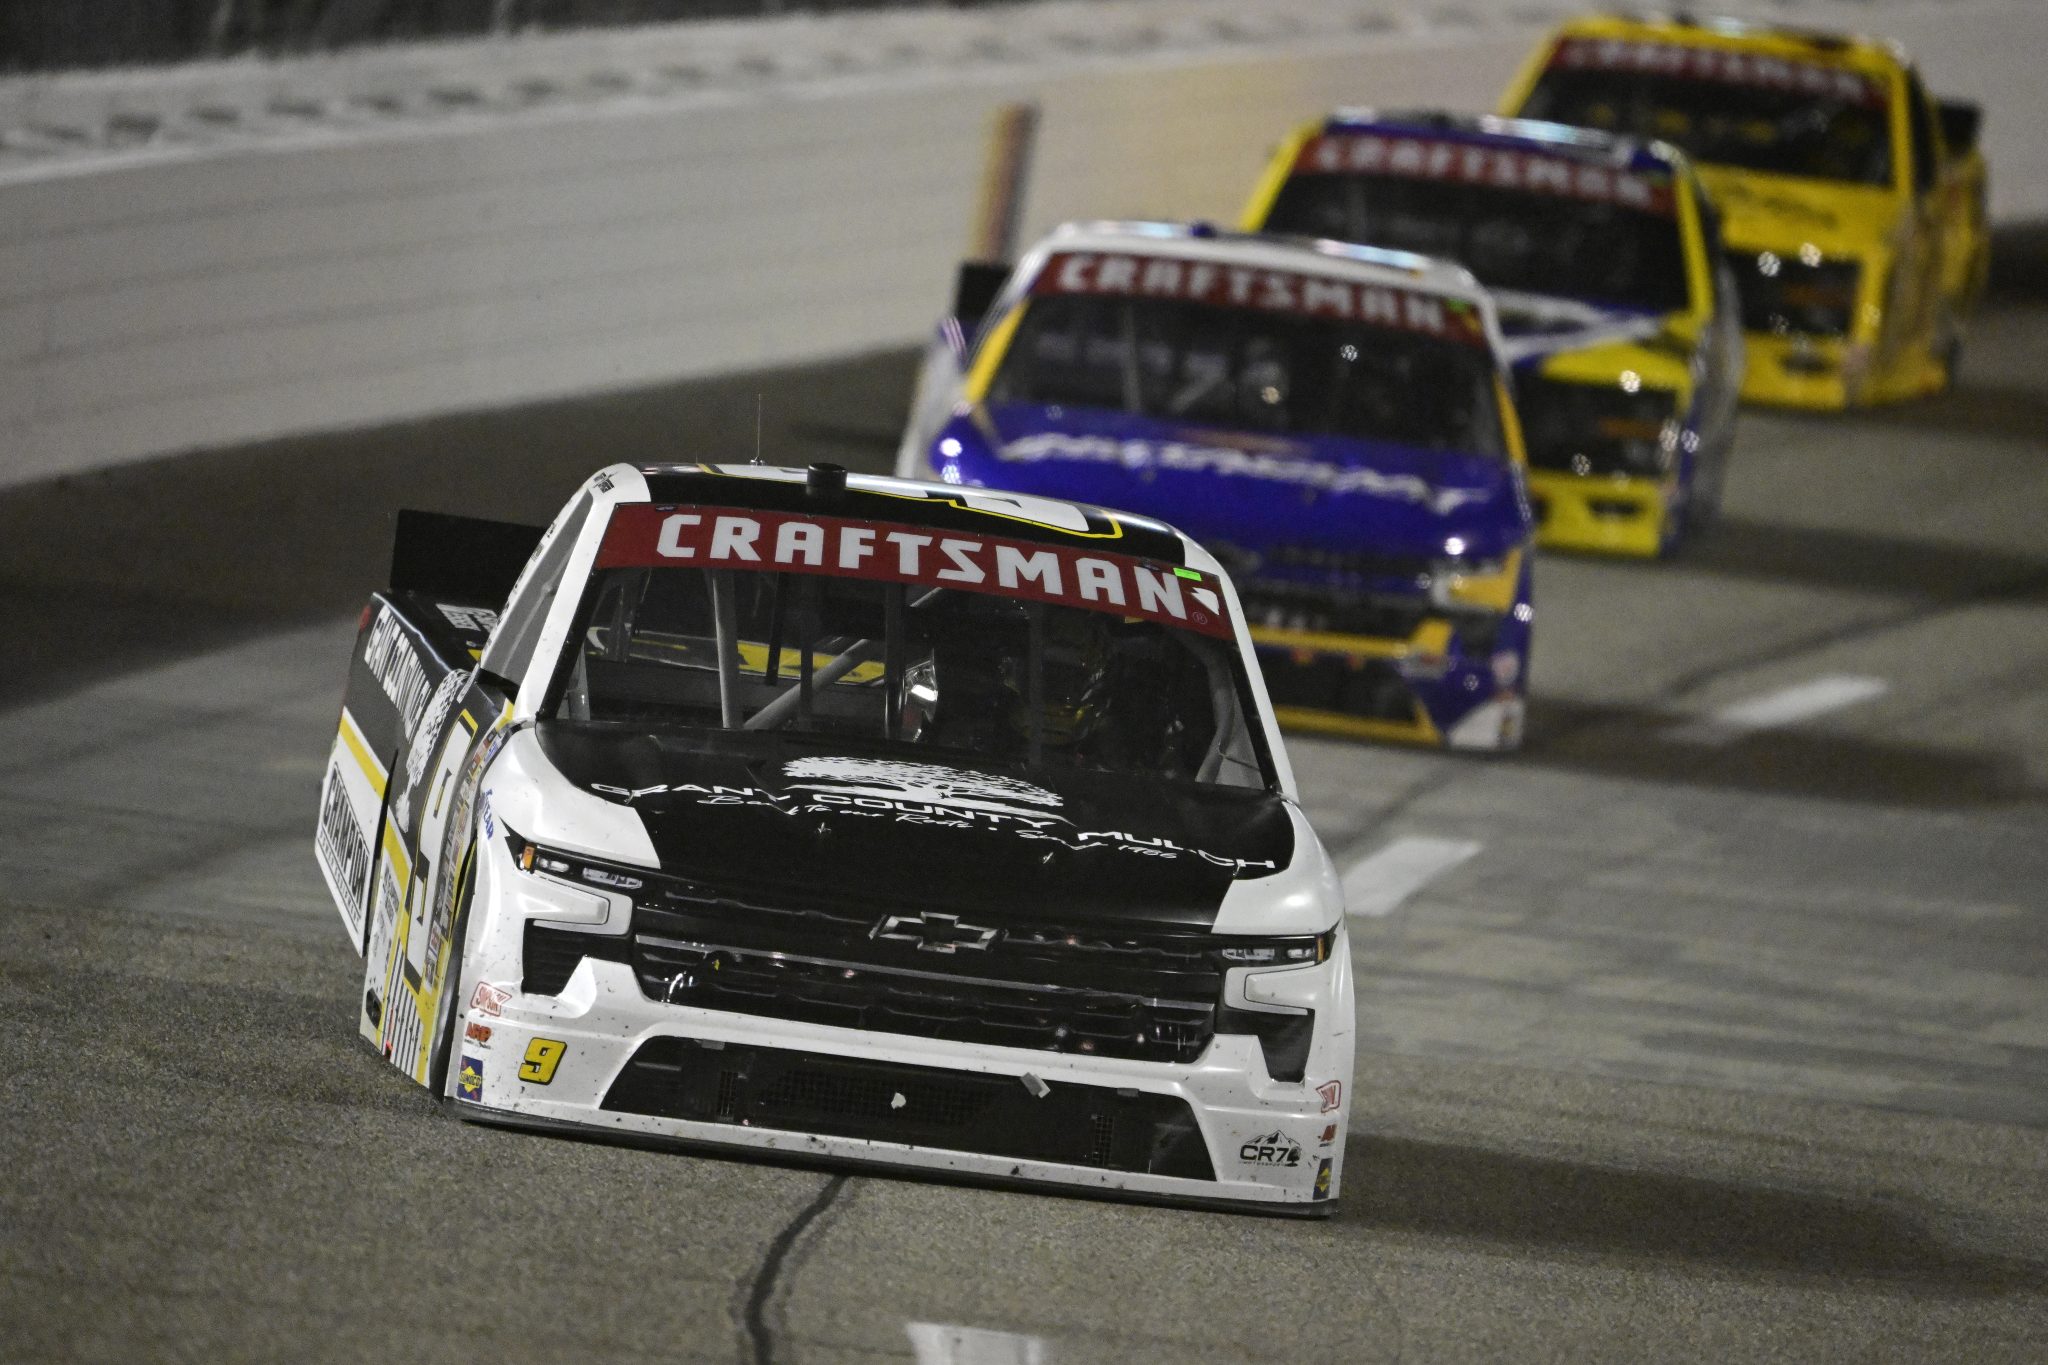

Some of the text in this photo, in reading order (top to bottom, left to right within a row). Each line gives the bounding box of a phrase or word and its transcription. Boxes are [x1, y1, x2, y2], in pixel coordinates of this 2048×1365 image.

[1315, 134, 1652, 204] CRAFTSMAN
[1056, 253, 1444, 334] CRAFTSMAN
[656, 513, 1188, 621] CRAFTSMAN
[812, 793, 1057, 829] COUNTY
[1077, 831, 1276, 869] MULCH
[518, 1037, 567, 1085] 9
[1240, 1144, 1290, 1162] CR7
